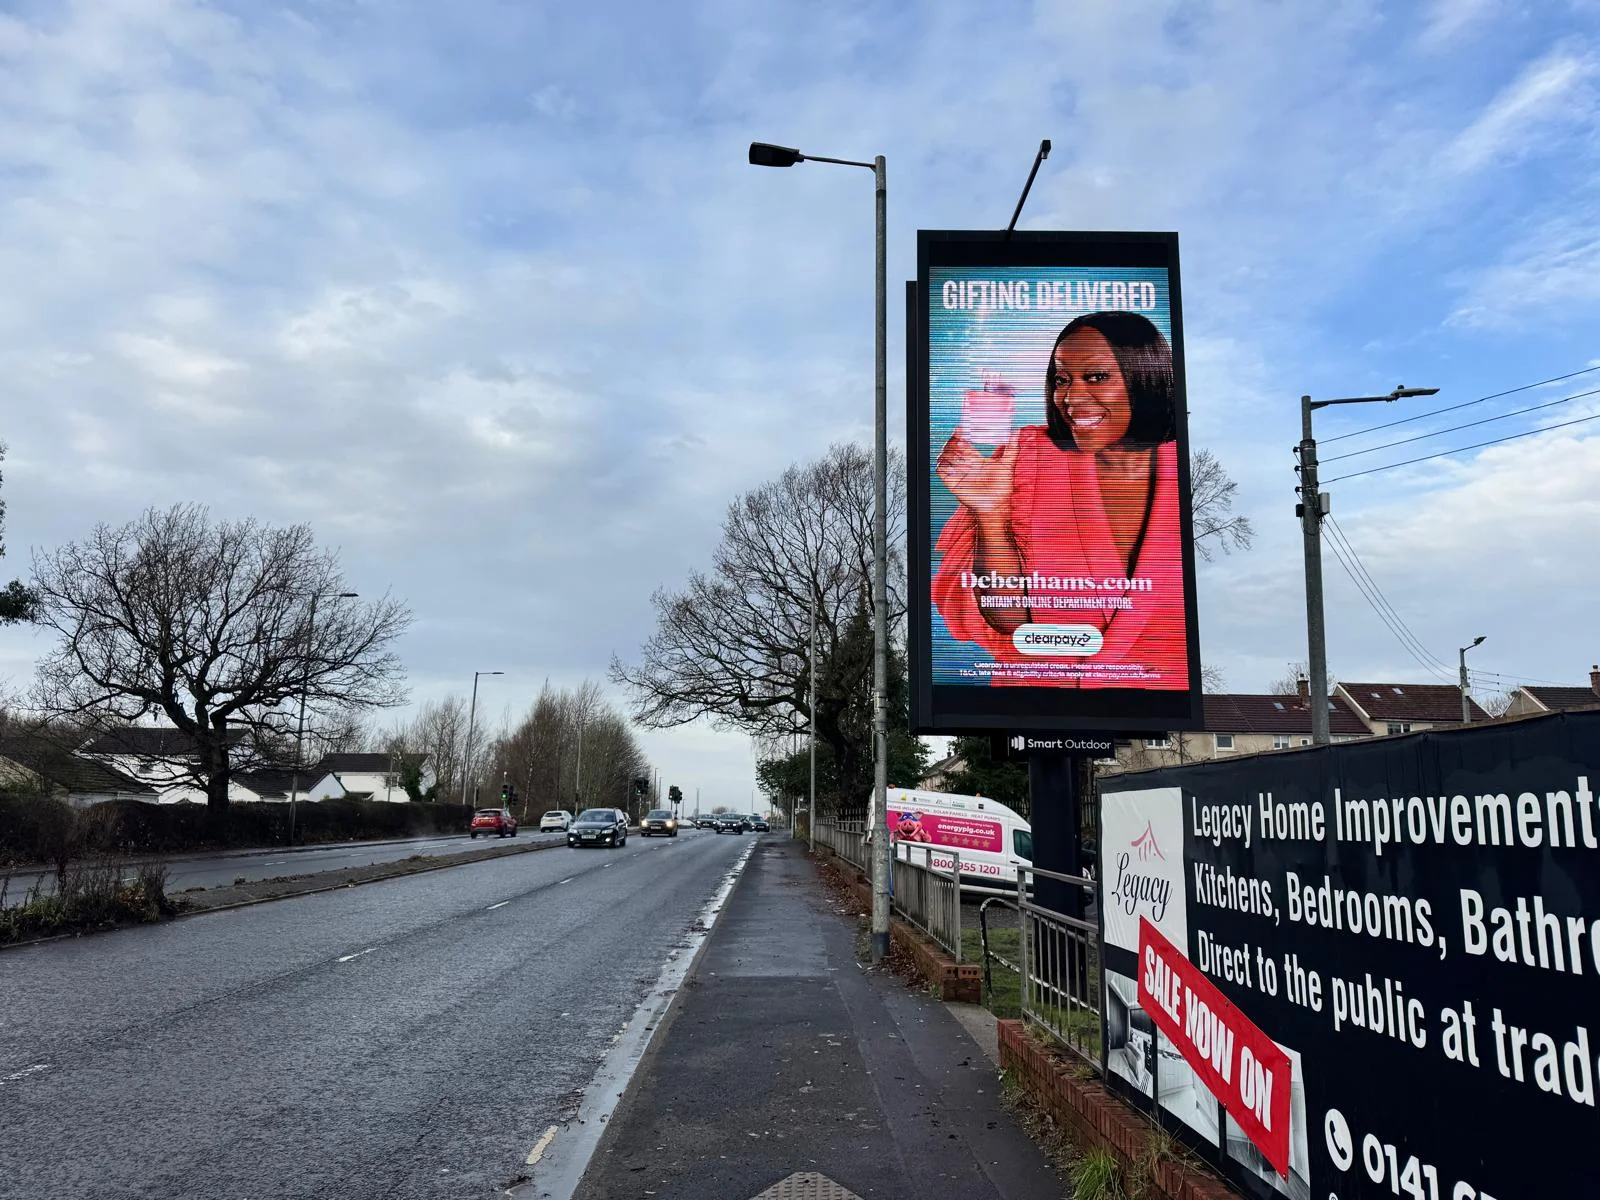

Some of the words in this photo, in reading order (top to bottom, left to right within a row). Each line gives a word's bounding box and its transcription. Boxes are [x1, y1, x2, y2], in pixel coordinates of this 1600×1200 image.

[942, 280, 1029, 310] GIFTING
[1037, 281, 1156, 312] DELIVERED
[960, 571, 1152, 591] Debenhams.com
[980, 595, 1021, 608] BRITAIN'S
[1022, 596, 1052, 608] ONLINE
[1053, 596, 1107, 609] DEPARTMENT
[1107, 596, 1133, 609] STORE
[1024, 632, 1078, 646] clearpay
[1027, 738, 1063, 748] Smart
[1065, 739, 1111, 749] Outdoor
[937, 824, 995, 835] energypig.co.uk
[1191, 796, 1251, 848] Legacy
[1259, 792, 1325, 841] Home
[1335, 775, 1600, 856] Improvement
[931, 858, 954, 869] 800
[959, 861, 976, 872] 955
[979, 864, 1000, 875] 1201
[1111, 852, 1173, 923] Legacy
[1194, 862, 1280, 926] Kitchens,
[1286, 871, 1447, 960] Bedrooms,
[1198, 929, 1252, 988] Direct
[1257, 947, 1278, 997] to
[1284, 953, 1323, 1012] the
[1331, 973, 1427, 1048] public
[1440, 1000, 1480, 1067] at
[1492, 1009, 1600, 1107] trad
[1144, 944, 1181, 1027] SALE
[1185, 986, 1234, 1085] NOW
[1240, 1046, 1273, 1132] ON
[1363, 1133, 1439, 1200] 0141
